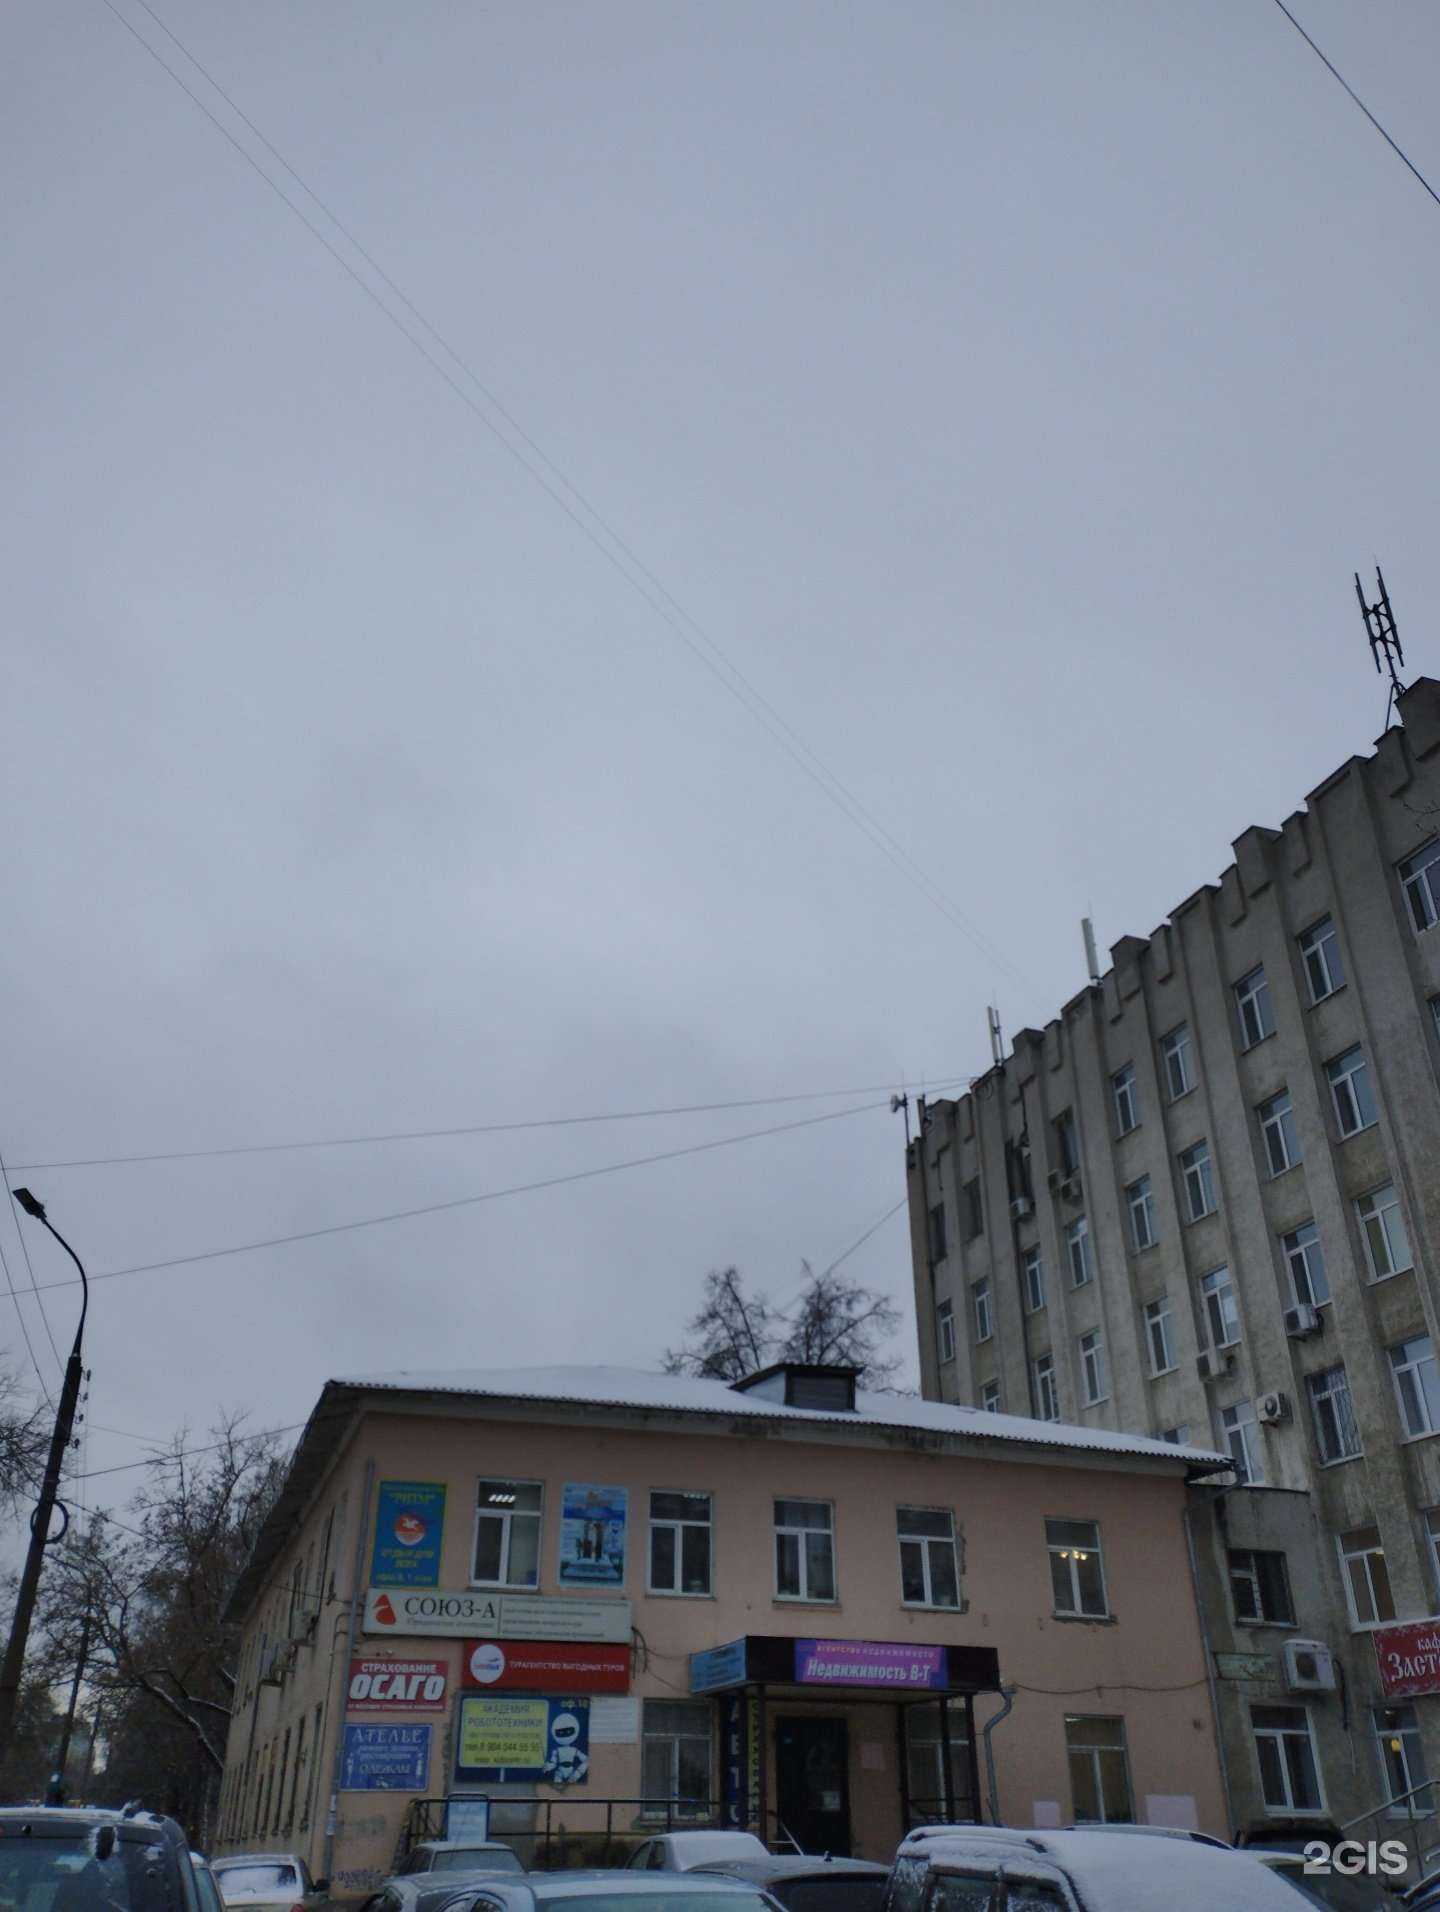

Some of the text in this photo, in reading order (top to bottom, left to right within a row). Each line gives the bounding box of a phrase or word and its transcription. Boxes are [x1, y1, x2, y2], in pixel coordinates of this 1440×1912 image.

[404, 1597, 496, 1619] СОЮЗ-А
[361, 1663, 437, 1674] СТРАХОВАНИЕ
[808, 1658, 907, 1680] Недвижимость
[1387, 1652, 1440, 1682] ЗАСТ
[349, 1673, 446, 1700] ОСАГО
[352, 1728, 423, 1743] АТЕЛЬЕ
